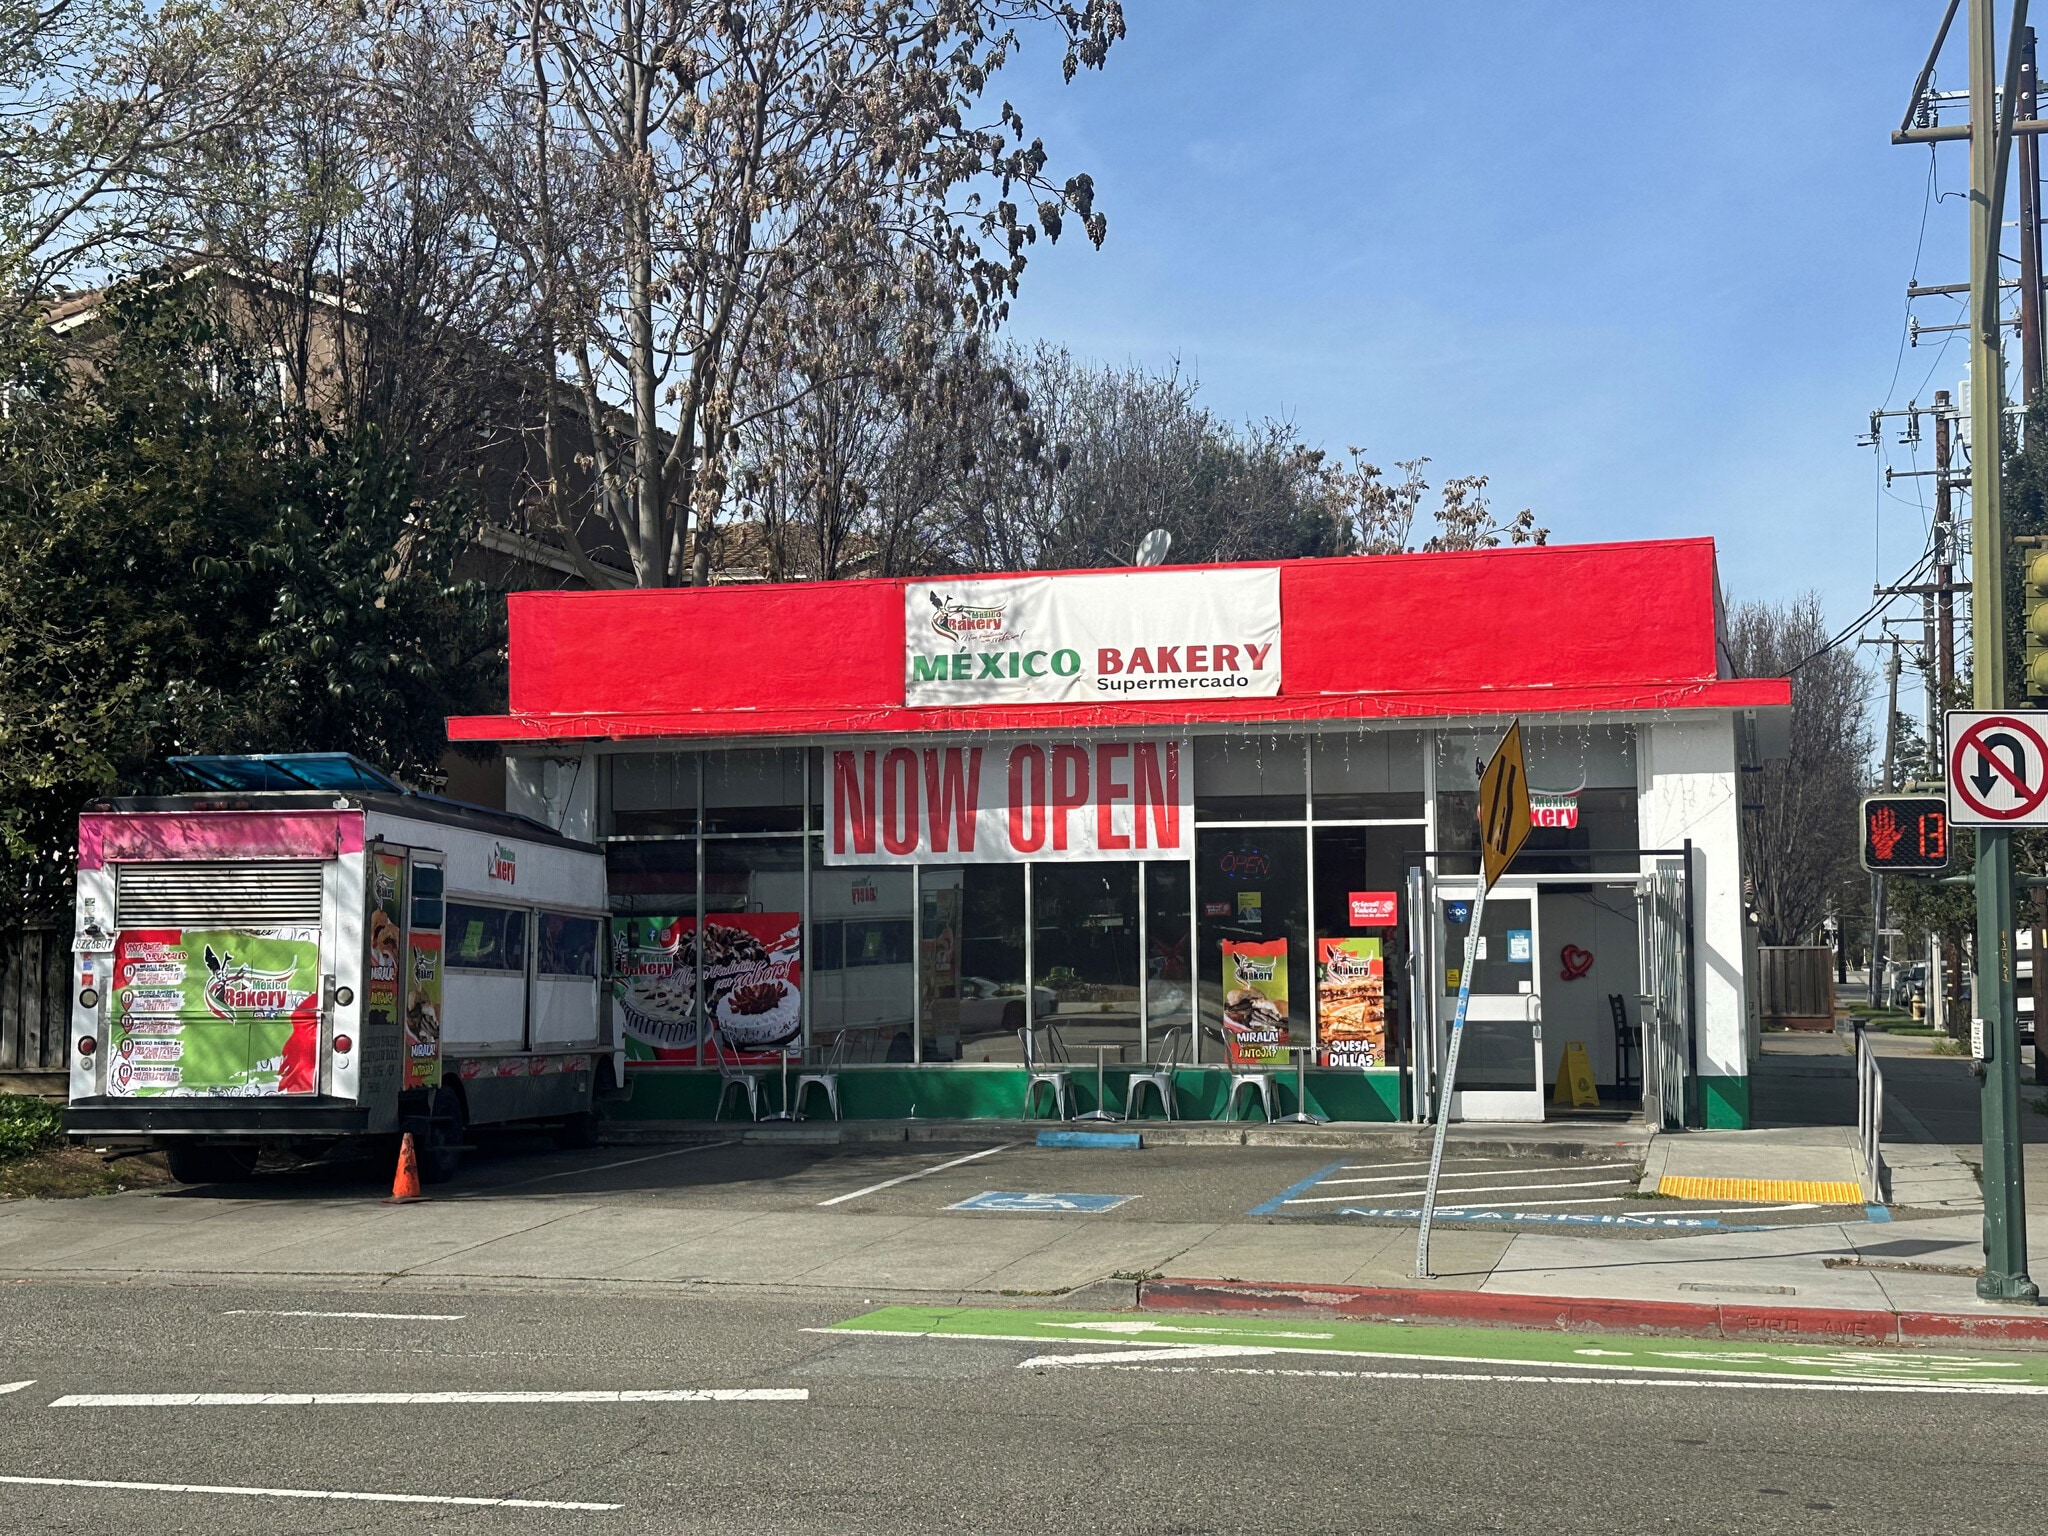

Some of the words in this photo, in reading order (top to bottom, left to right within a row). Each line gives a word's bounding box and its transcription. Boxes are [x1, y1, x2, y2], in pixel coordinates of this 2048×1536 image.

[949, 618, 1001, 630] Bakery
[913, 645, 1081, 682] MÉXICO
[1097, 644, 1273, 675] BAKERY
[1097, 674, 1249, 693] Supermercado
[833, 747, 983, 855] NOW
[1007, 741, 1181, 853] OPEN
[1530, 807, 1579, 828] kery
[1919, 812, 1944, 858] 13
[1220, 853, 1270, 875] OPEN
[224, 988, 287, 1008] Bakery
[1236, 1030, 1279, 1043] MIRALA!
[1331, 1039, 1376, 1053] QUESA-
[1329, 1052, 1374, 1067] DILLAS
[1824, 1320, 1867, 1338] AVE
